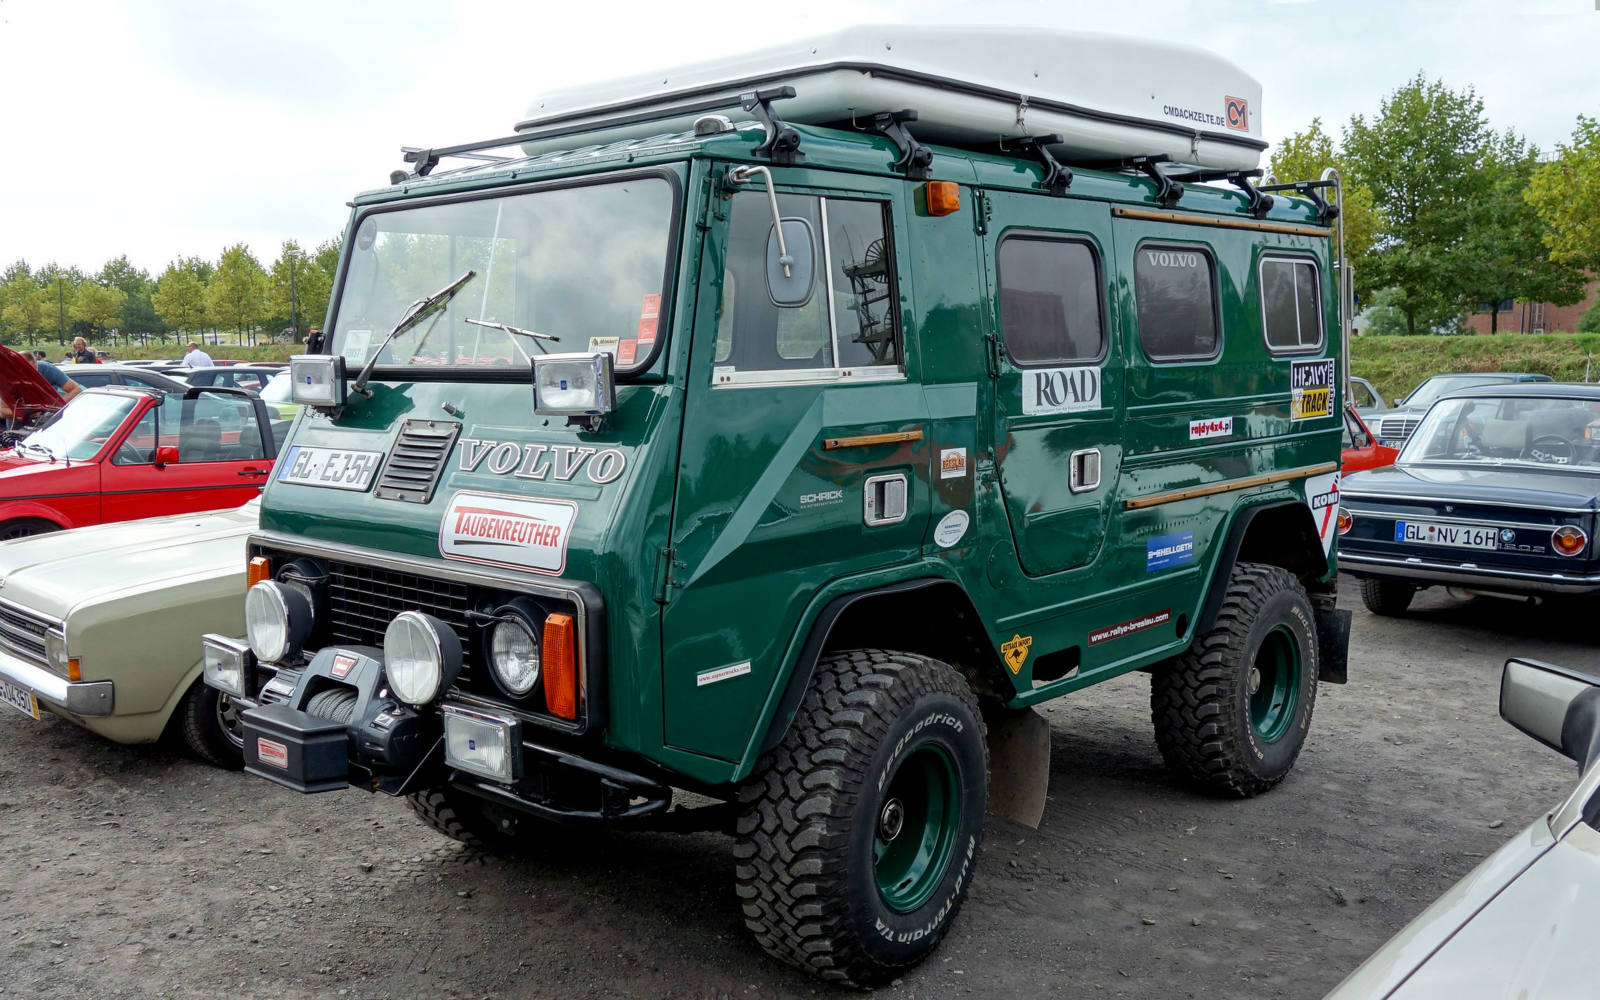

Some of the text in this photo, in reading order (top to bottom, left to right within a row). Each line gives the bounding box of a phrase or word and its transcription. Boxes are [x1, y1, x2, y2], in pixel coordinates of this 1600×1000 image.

[1163, 105, 1226, 127] CMDACHZELTE.DE
[1227, 101, 1247, 128] CM
[1147, 252, 1197, 268] VOLVO
[1035, 369, 1097, 407] ROAD
[1294, 365, 1328, 388] HEAVY
[1302, 392, 1328, 413] TRACK
[1191, 420, 1232, 436] rajdy4x4.pl
[290, 451, 313, 479] GL
[457, 439, 627, 485] VOLVO
[800, 490, 843, 504] SCHRICK
[1313, 491, 1338, 508] KONI
[454, 505, 562, 547] TAUBENREUTHER
[1406, 525, 1497, 547] GL NV 16H
[1091, 613, 1169, 642] www.rallye-breslau.com
[878, 713, 964, 792] BFGoodrich
[898, 835, 976, 944] Mud-Terrain
